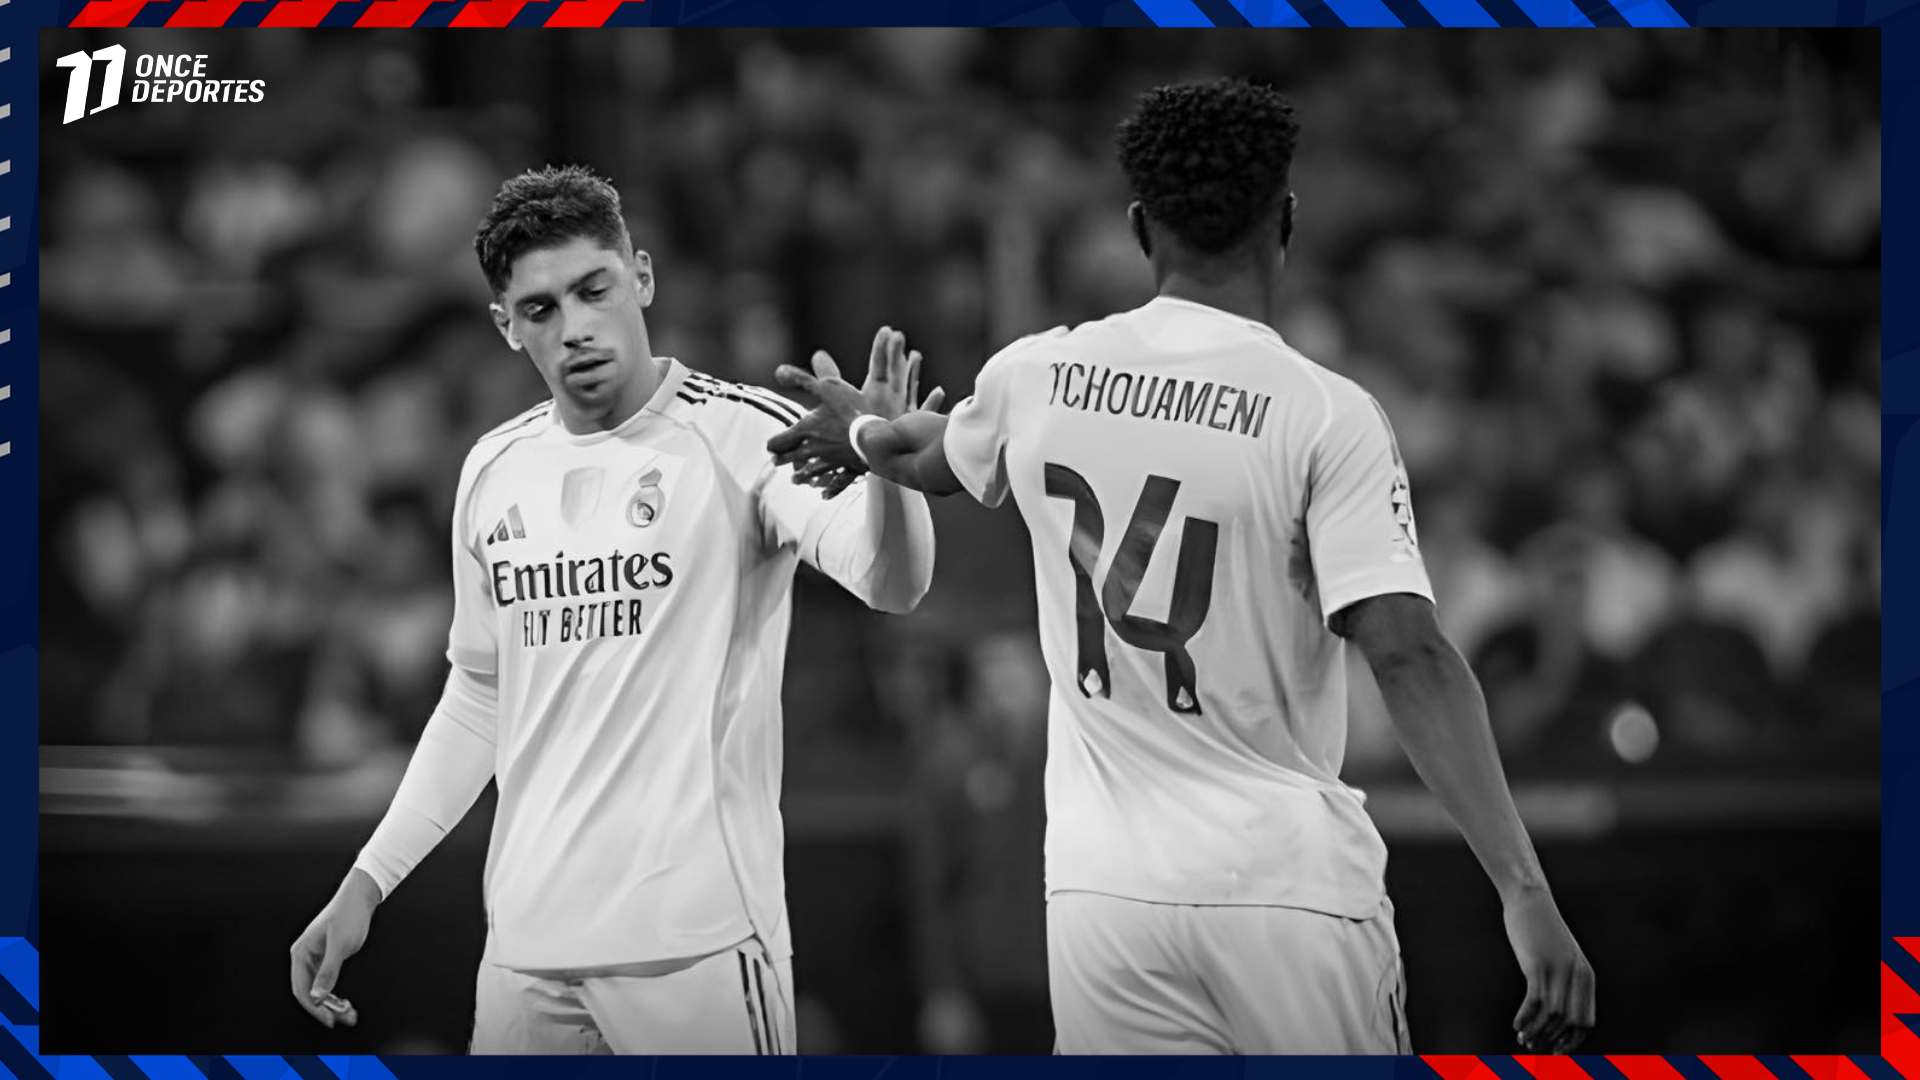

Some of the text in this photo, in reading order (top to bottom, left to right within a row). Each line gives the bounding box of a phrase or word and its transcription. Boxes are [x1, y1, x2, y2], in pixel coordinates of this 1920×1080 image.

[492, 549, 674, 608] Emirates
[1044, 461, 1219, 717] 14
[560, 599, 643, 643] BETTER
